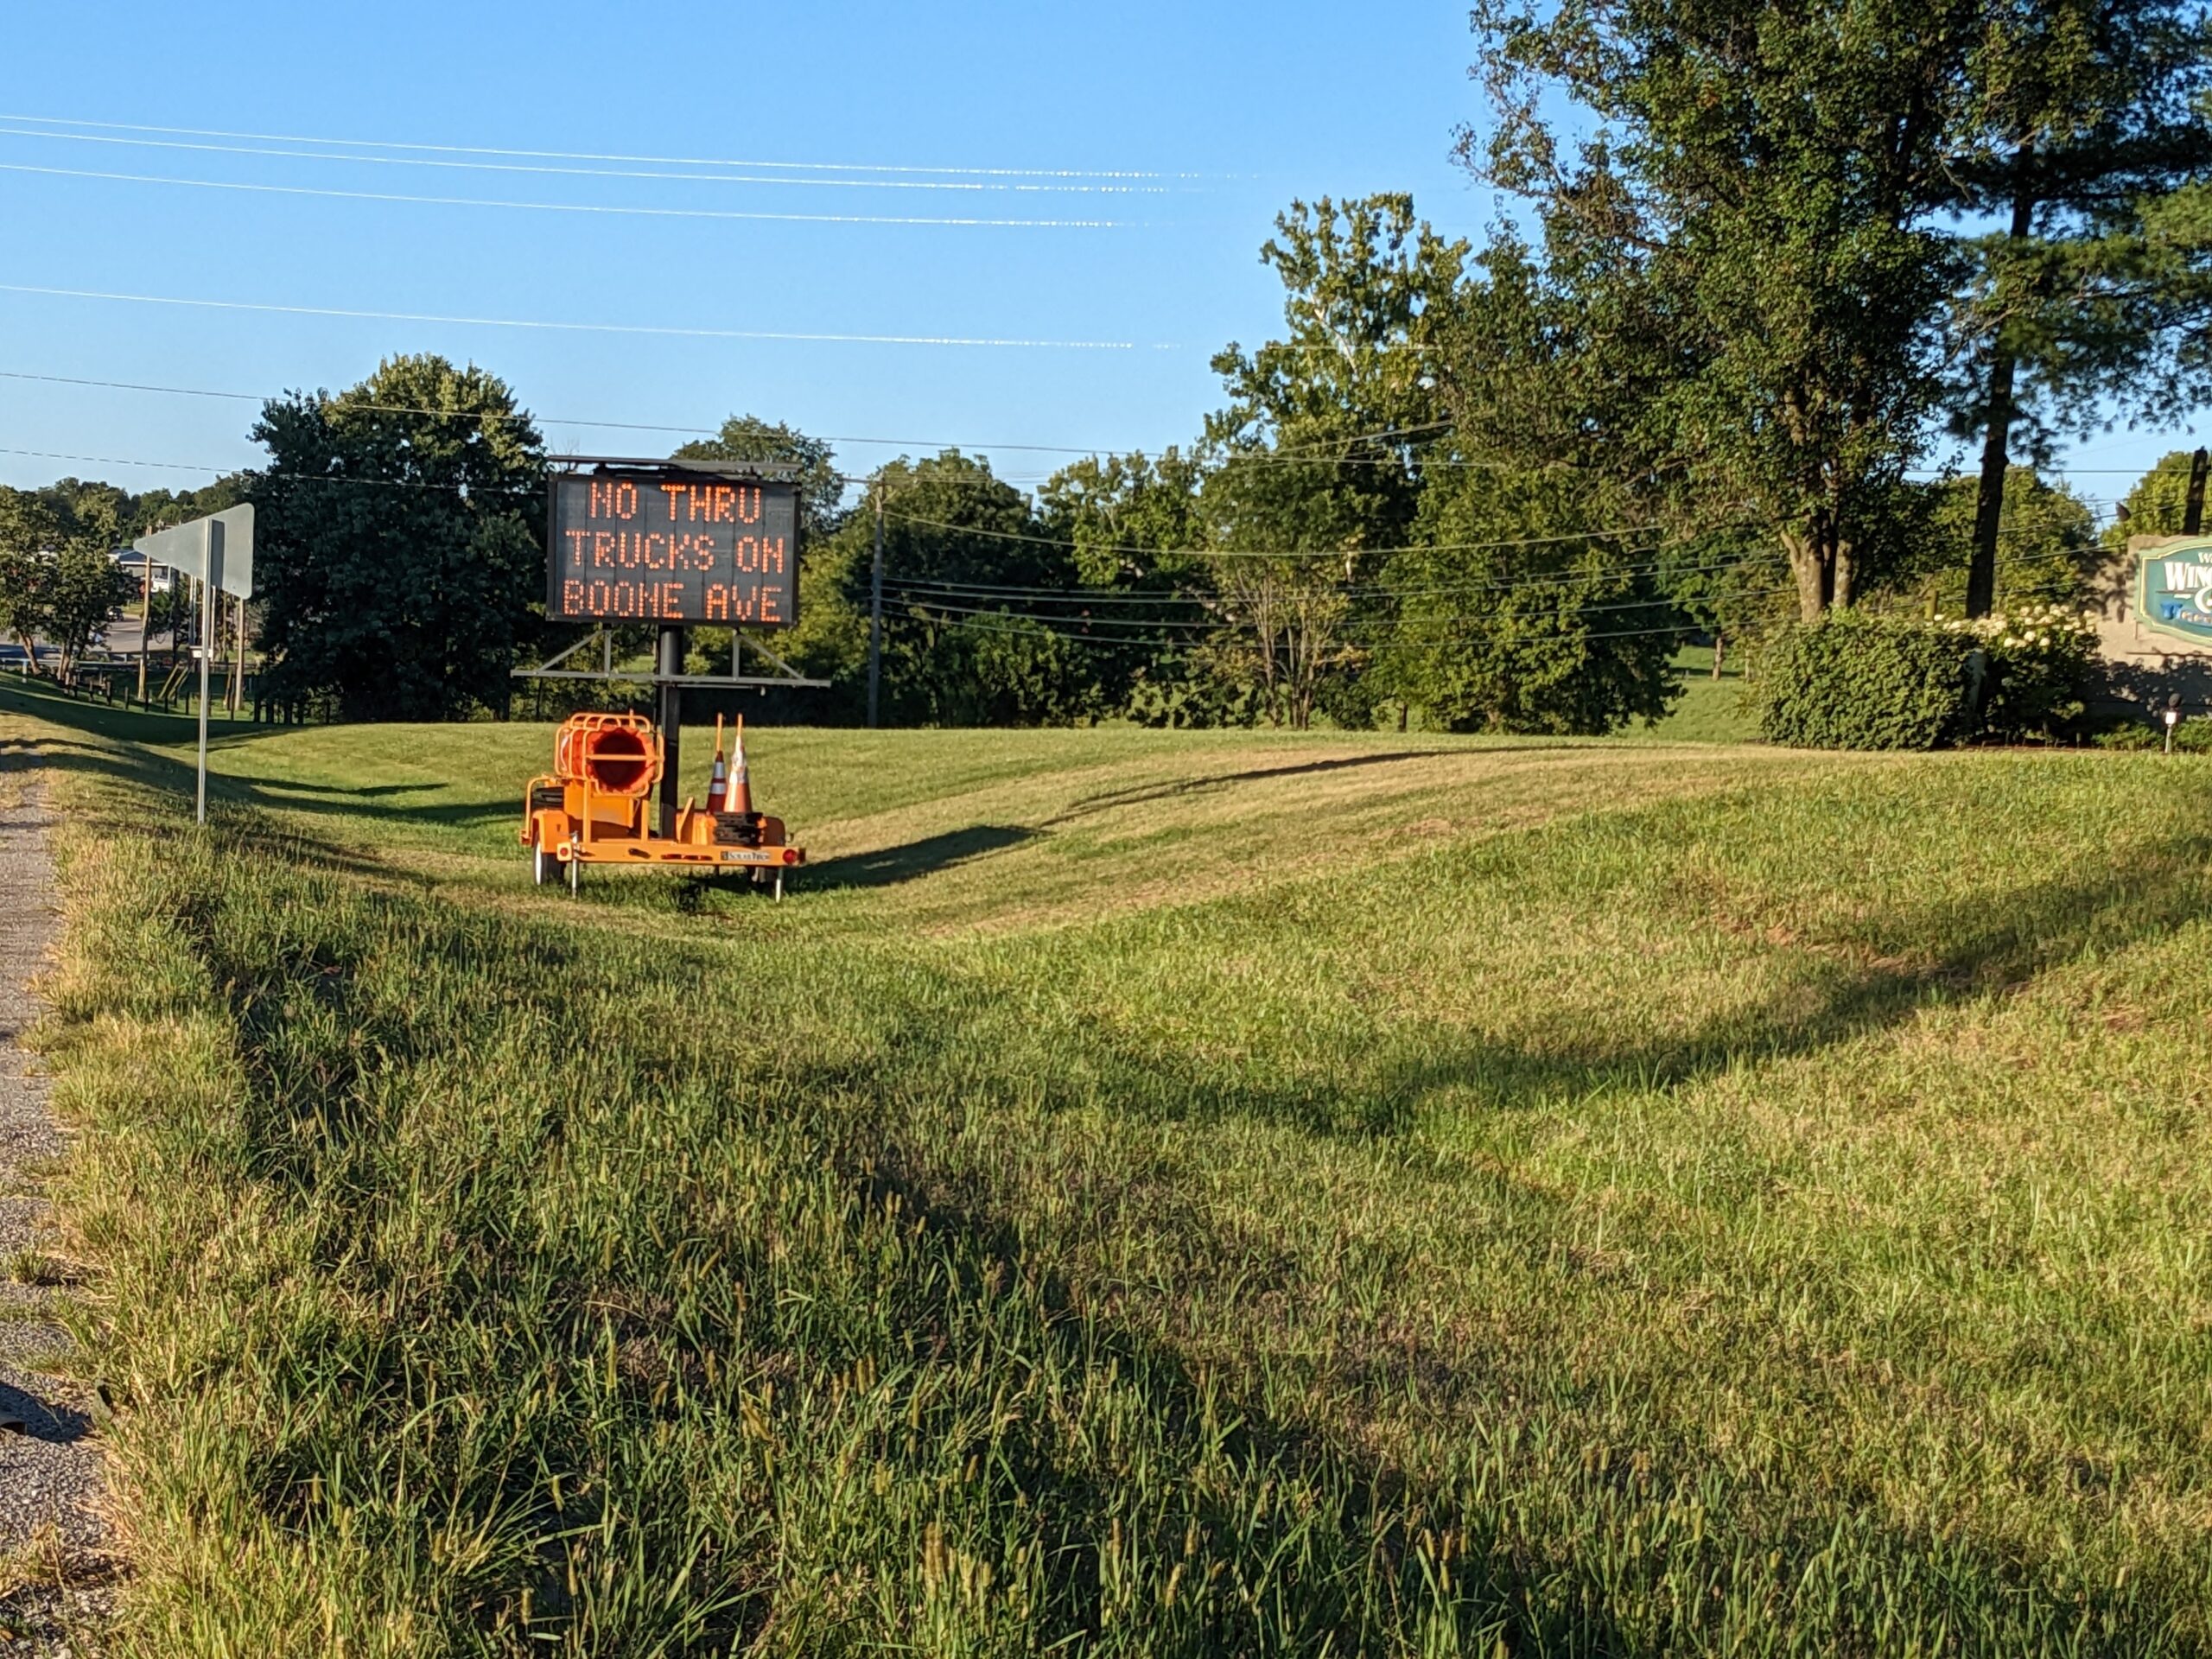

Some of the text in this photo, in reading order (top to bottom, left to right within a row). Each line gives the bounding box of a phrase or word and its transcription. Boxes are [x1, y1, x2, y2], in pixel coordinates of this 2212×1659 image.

[589, 481, 762, 524] NO THRU
[564, 530, 785, 574] TRUCKS ON
[563, 579, 783, 622] BOONE AVE
